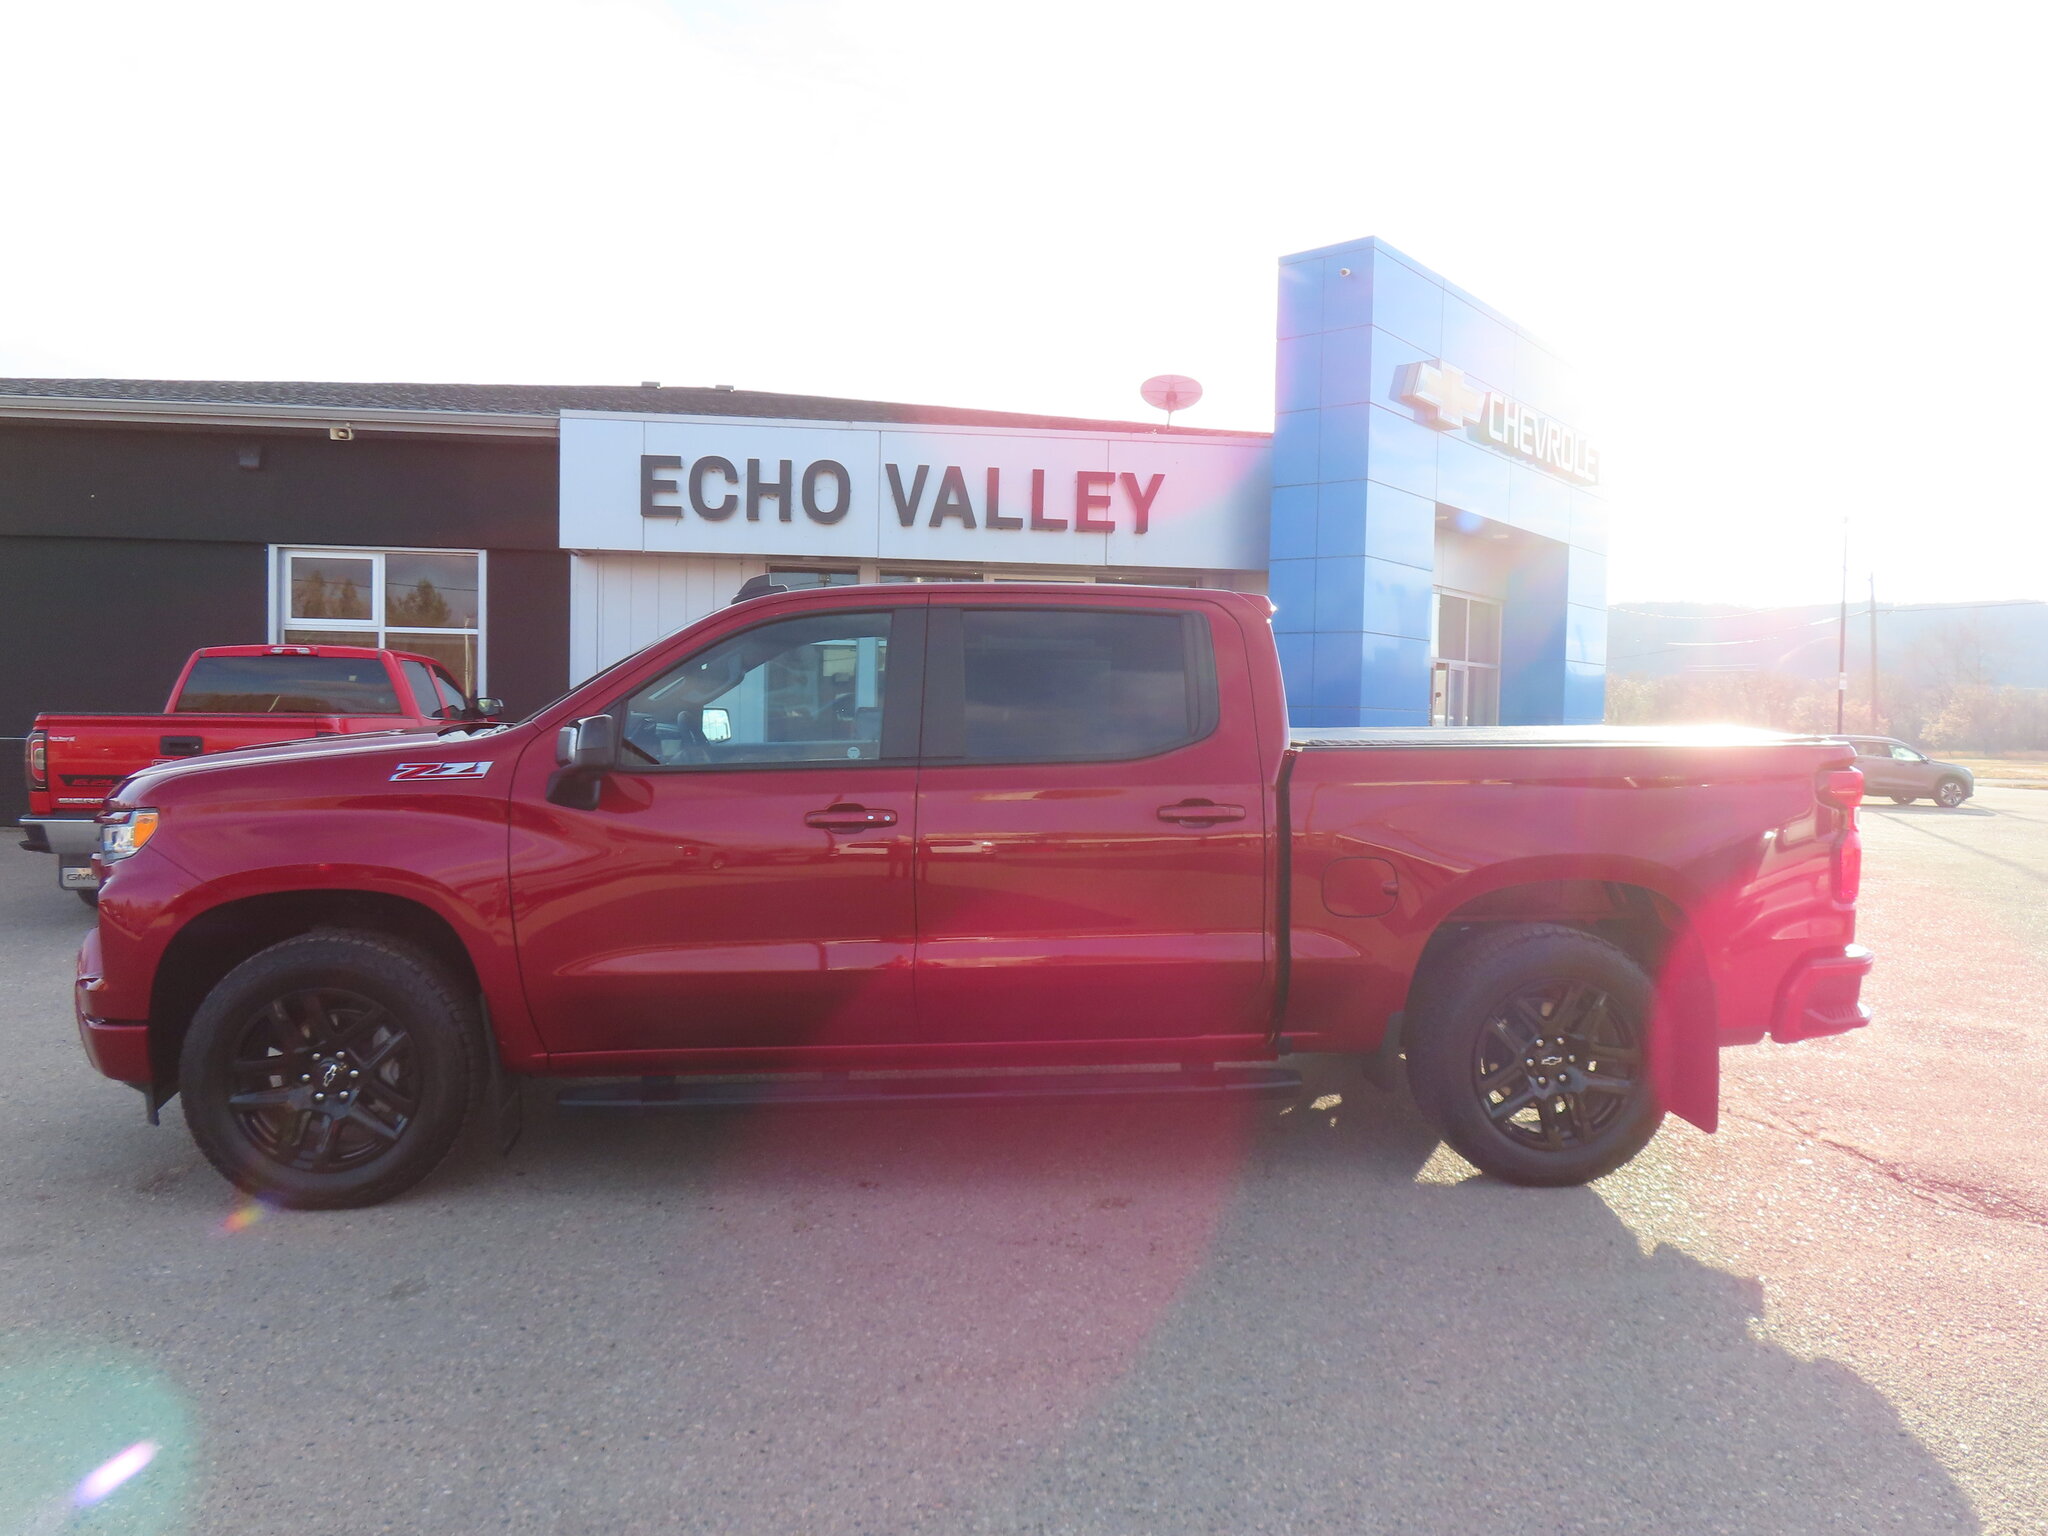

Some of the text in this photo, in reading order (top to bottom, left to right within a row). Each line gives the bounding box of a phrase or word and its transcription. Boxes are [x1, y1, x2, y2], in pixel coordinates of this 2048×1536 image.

[1486, 391, 1599, 484] CHEVROLE
[640, 454, 1166, 535] ECHO VALLEY
